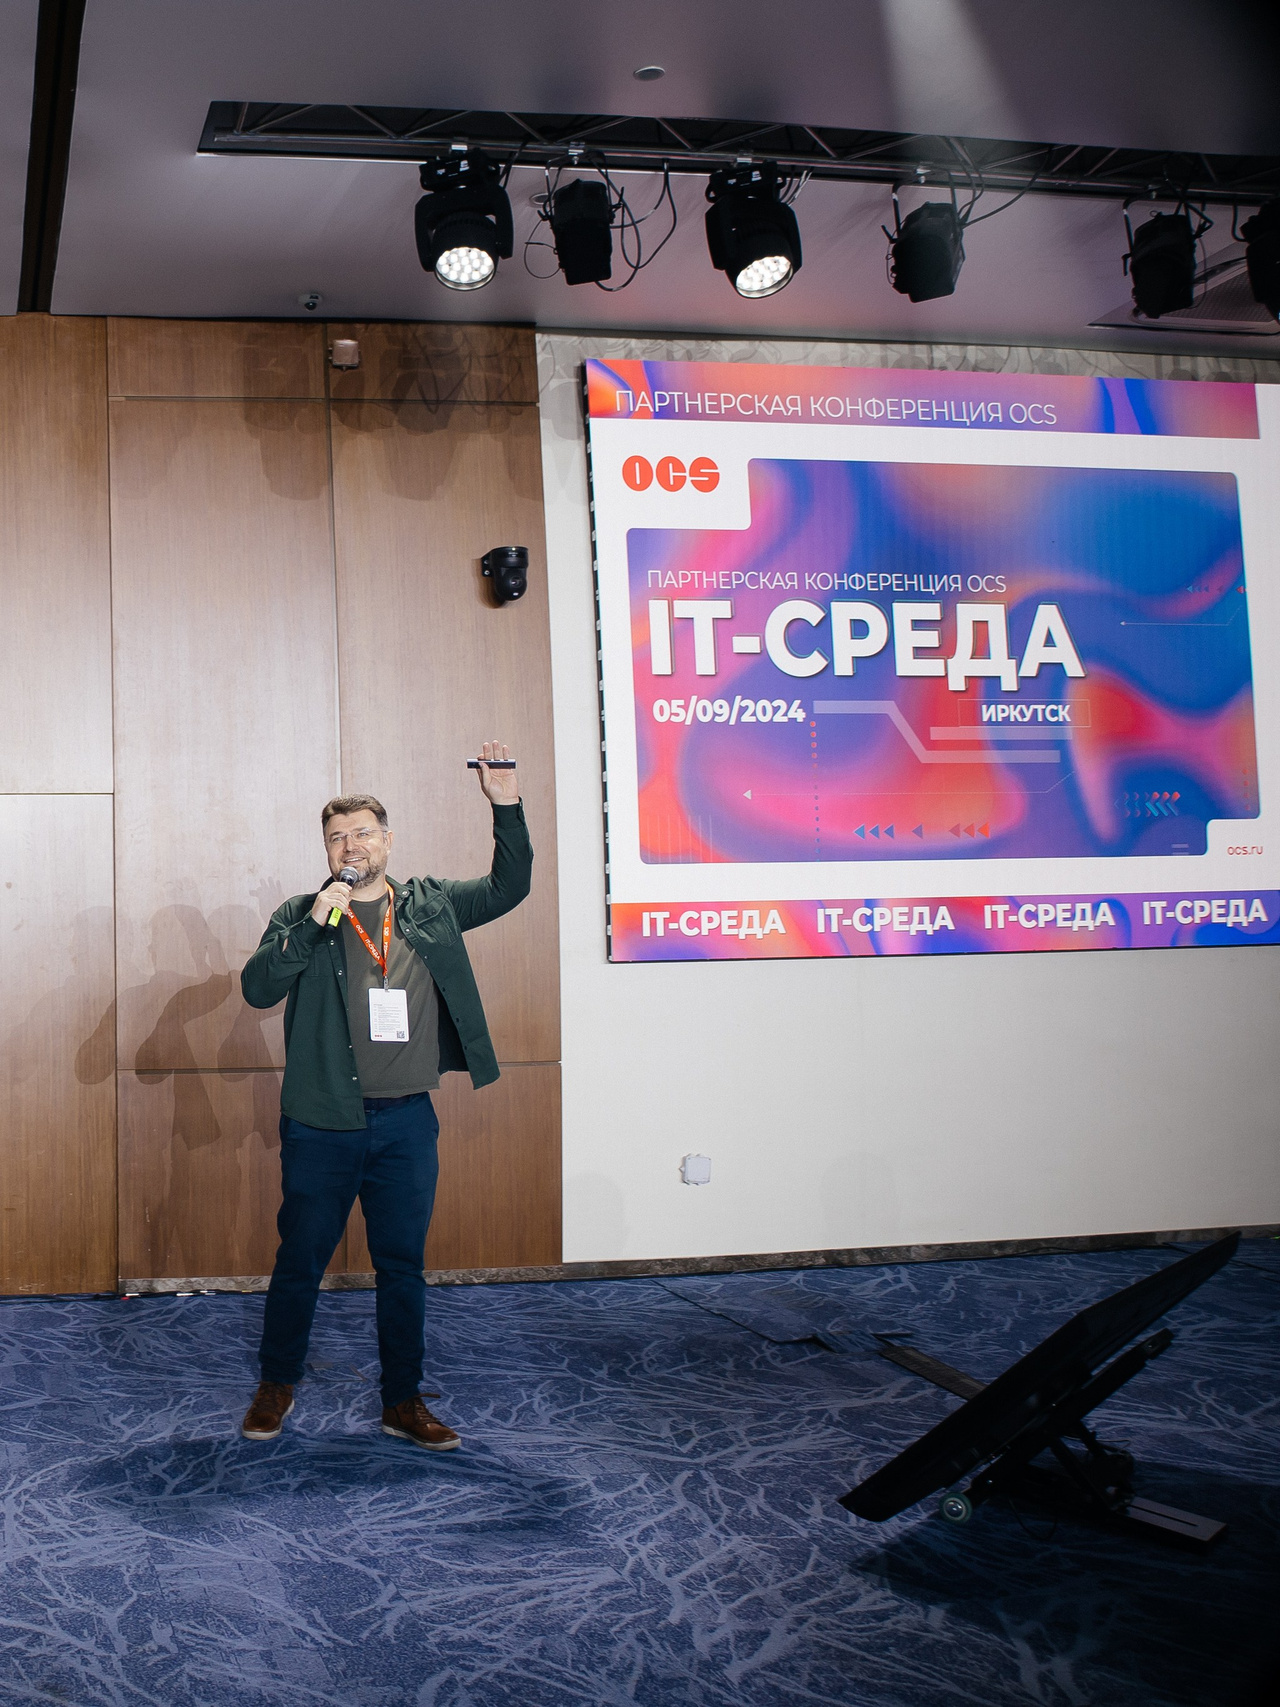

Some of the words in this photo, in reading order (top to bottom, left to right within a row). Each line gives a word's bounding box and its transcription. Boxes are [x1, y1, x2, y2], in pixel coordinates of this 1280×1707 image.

[615, 391, 803, 417] ПАРТНЕРСКАЯ
[809, 396, 1003, 426] КОНФЕРЕНЦИЯ
[1008, 402, 1057, 426] OCS
[647, 570, 799, 590] ПАРТНЕРСКАЯ
[805, 572, 962, 596] КОНФЕРЕНЦИЯ
[967, 575, 1006, 593] OCS
[649, 599, 1087, 692] IT-СРЕДА
[652, 695, 807, 727] 05/09/2024
[981, 703, 1072, 724] ИРКУТСК
[1227, 844, 1264, 857] ocs.ru
[642, 909, 786, 939] IT-СРЕДА
[817, 905, 956, 934] IT-СРЕДА
[984, 903, 1116, 931] IT-СРЕДА
[1142, 898, 1268, 927] IT-СРЕДА
